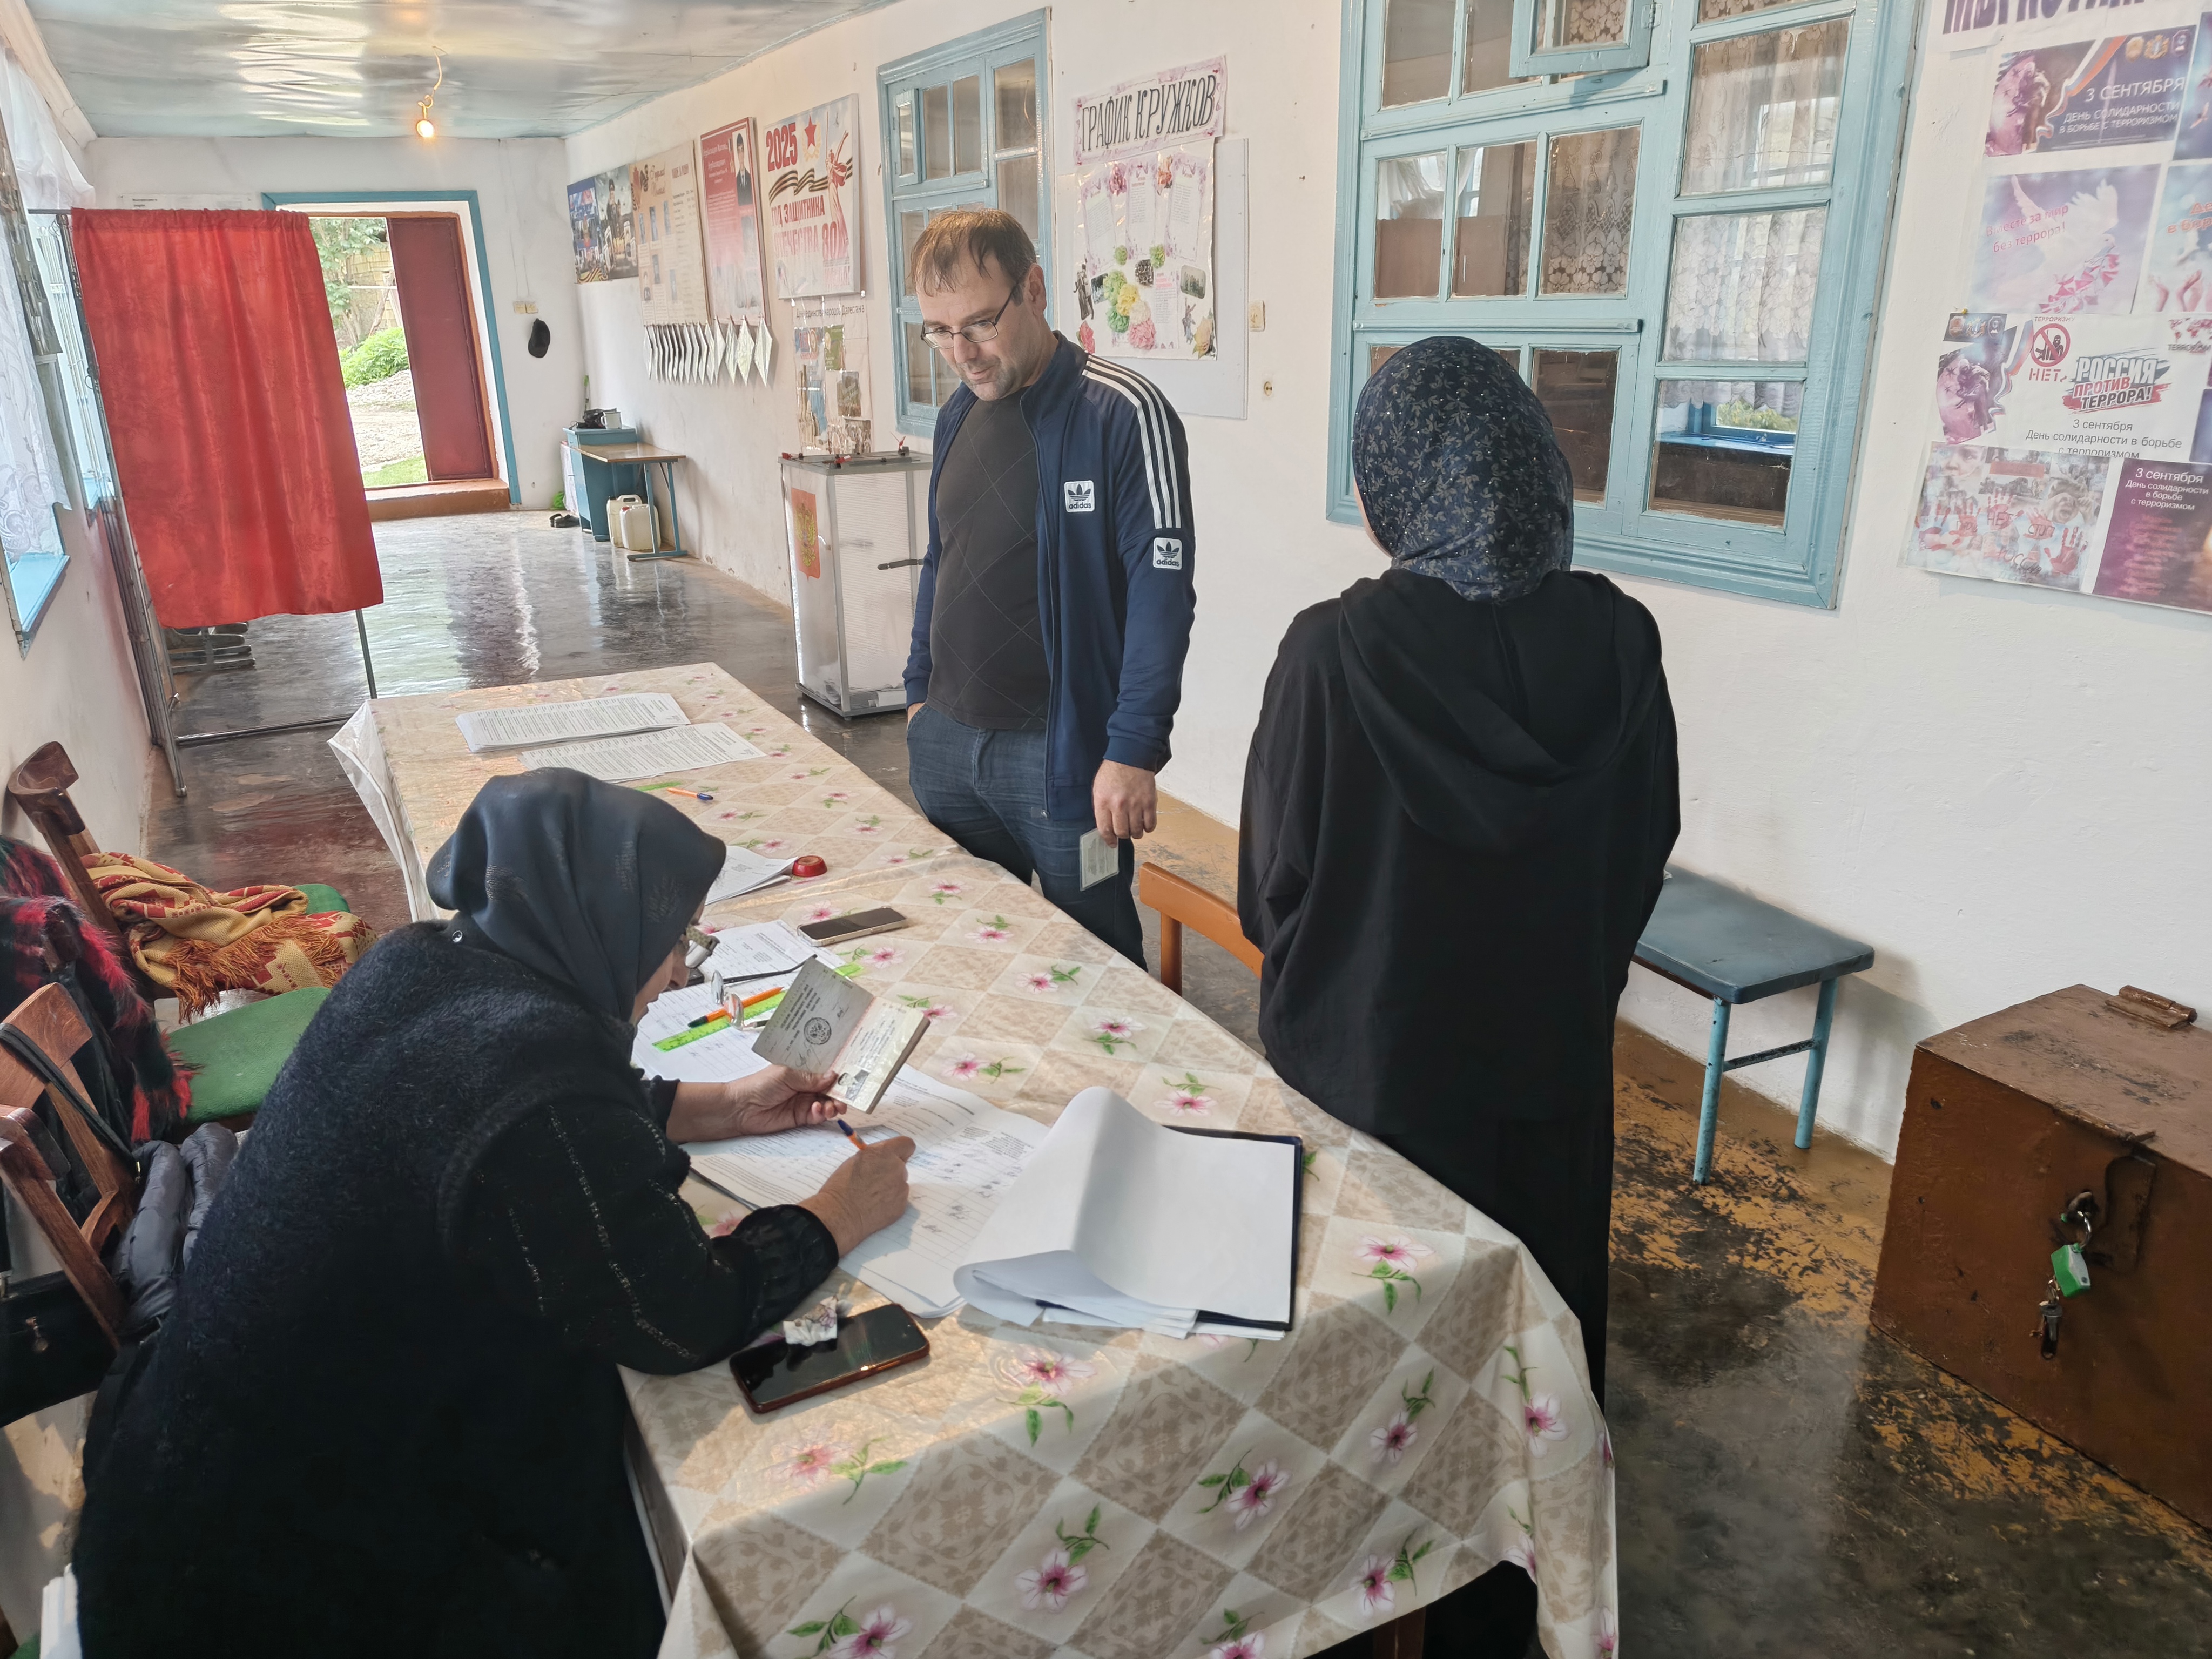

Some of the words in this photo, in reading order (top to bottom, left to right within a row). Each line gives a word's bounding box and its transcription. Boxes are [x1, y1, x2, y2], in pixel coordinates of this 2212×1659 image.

[2085, 87, 2095, 102] 3
[2100, 76, 2187, 100] СЕНТЯБРЯ
[1082, 94, 1132, 151] ГРАФИК
[1134, 75, 1216, 140] КРУЖКОВ
[2063, 113, 2092, 124] ДЕНЬ
[2093, 101, 2180, 119] СОЛИДАРНОСТИ
[2067, 122, 2100, 133] БОРЬБЕ
[2112, 113, 2179, 127] ТЕРРОРИЗМОМ
[766, 122, 798, 172] 2025
[771, 205, 783, 227] ГОД
[784, 195, 825, 224] ЗАЩИТНИКА
[1986, 218, 2026, 237] Вместе
[2029, 213, 2041, 224] за
[2045, 205, 2069, 219] мир
[1993, 241, 2013, 252] без
[2015, 221, 2066, 246] террора!
[2076, 356, 2159, 385] РОССИЯ
[2072, 376, 2131, 399] ПРОТИВ
[2081, 386, 2153, 410] ТЕРРОРА!
[2073, 419, 2080, 428] 3
[2082, 421, 2133, 432] сентября
[2026, 430, 2050, 441] День
[2053, 431, 2128, 445] солидарности
[2141, 437, 2182, 449] борьбе
[2125, 480, 2146, 489] День
[2148, 483, 2209, 495] солидарности
[2135, 468, 2144, 478] 3
[2146, 469, 2204, 484] сентября
[2138, 499, 2195, 511] терроризмом
[2153, 491, 2183, 501] борьбе
[1156, 558, 1179, 567] adidas
